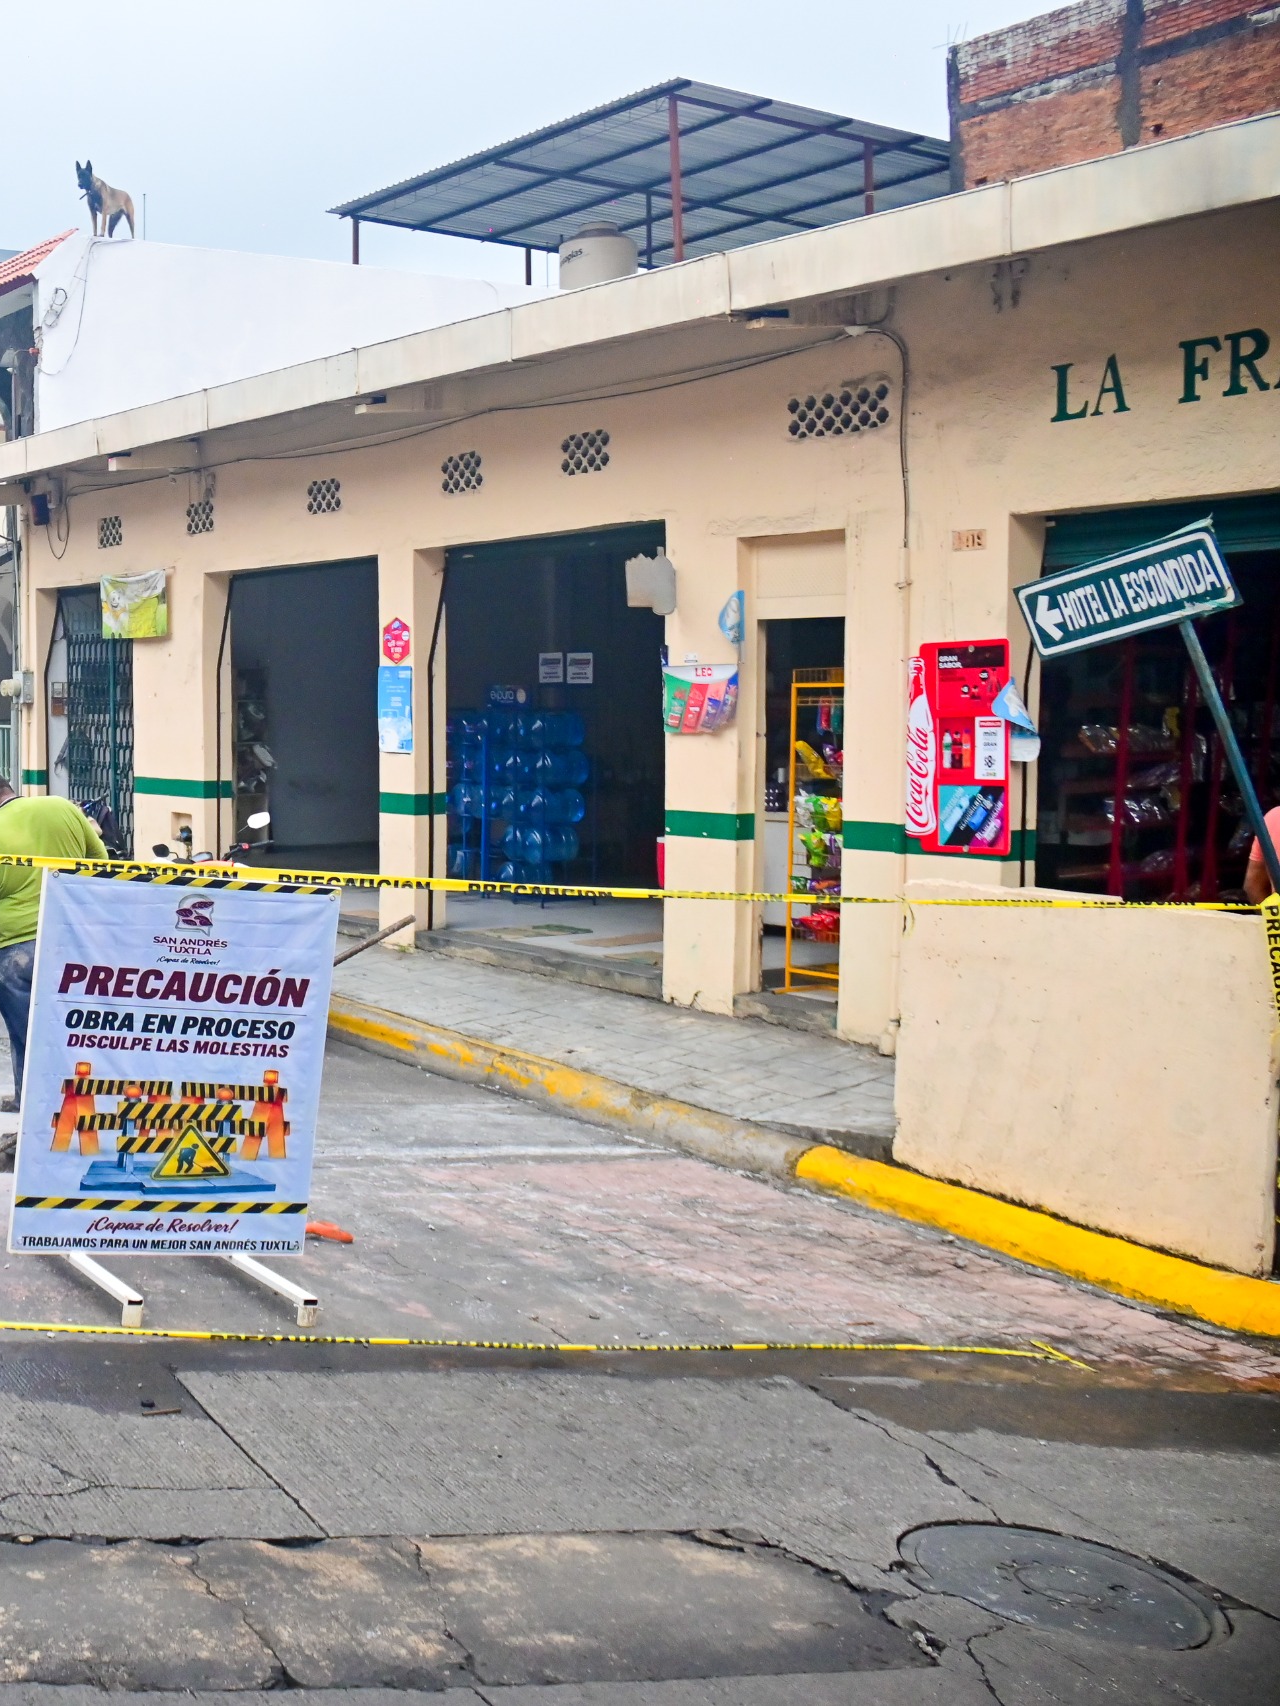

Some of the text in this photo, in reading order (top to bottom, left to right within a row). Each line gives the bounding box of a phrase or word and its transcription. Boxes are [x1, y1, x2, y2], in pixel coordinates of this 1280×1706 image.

[1050, 328, 1280, 423] LA FR
[1057, 550, 1221, 631] HOTEL LA ESCONDIDA
[153, 936, 228, 949] SAN ANDRÉS
[167, 945, 212, 955] TUXTLA
[58, 963, 310, 1008] PRECAUCIÓN
[64, 1009, 295, 1040] OBRA EN PROCESO
[67, 1033, 289, 1058] DISCULPE LAS MOLESTIAS
[86, 1216, 239, 1235] ¡Capaz de Resolver!
[22, 1236, 300, 1251] TRABAJAMOS PARA UN MEJOR SAN ANDRÉS TUXTLA
